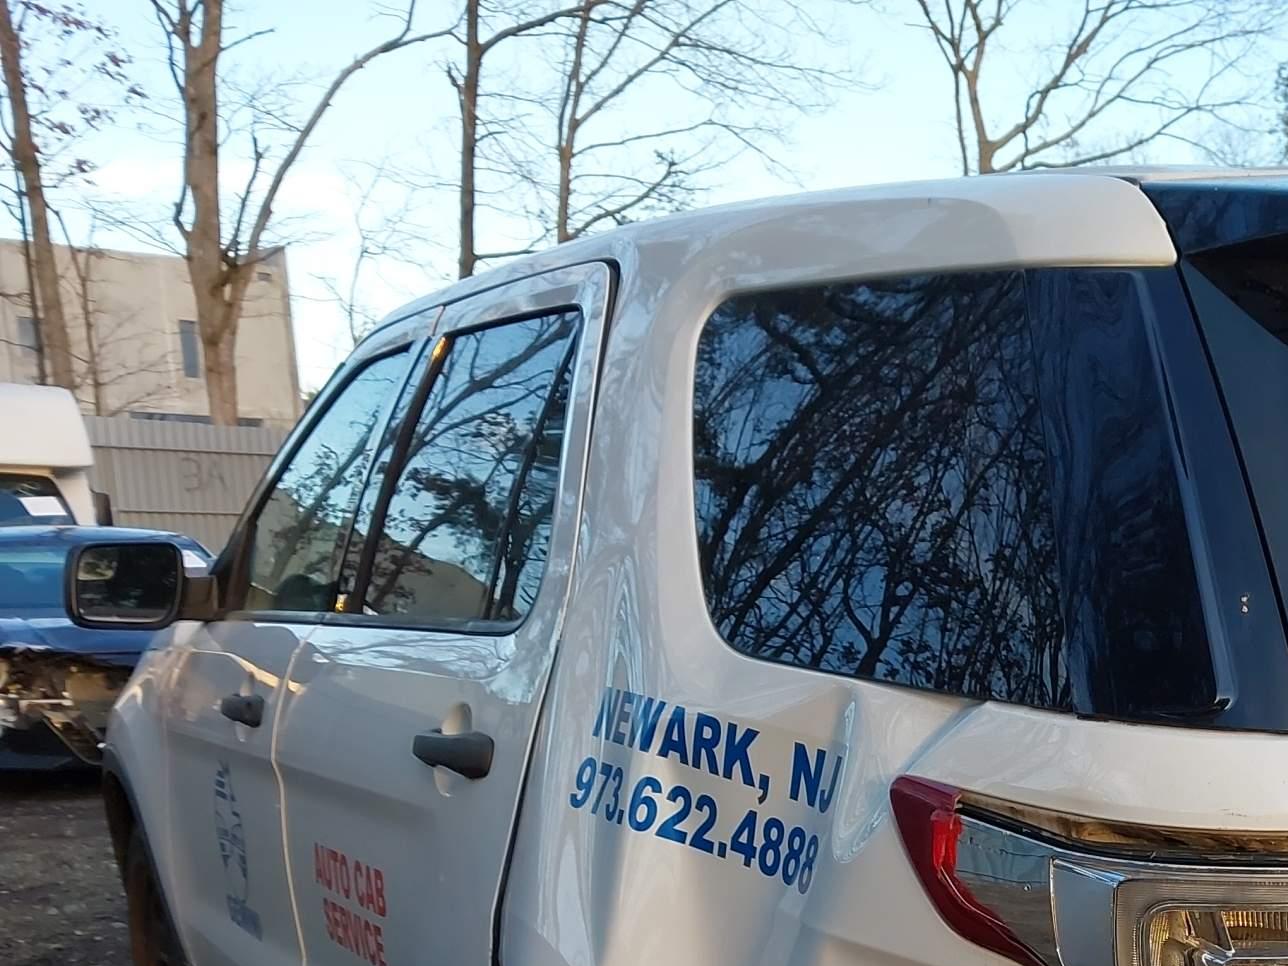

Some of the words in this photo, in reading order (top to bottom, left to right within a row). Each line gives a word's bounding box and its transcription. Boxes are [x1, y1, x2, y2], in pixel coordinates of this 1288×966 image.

[592, 686, 770, 804] NEWARK,
[788, 741, 843, 814] NJ
[314, 842, 351, 899] AUTO
[354, 860, 387, 917] CAB
[569, 757, 819, 894] 973.622.4888
